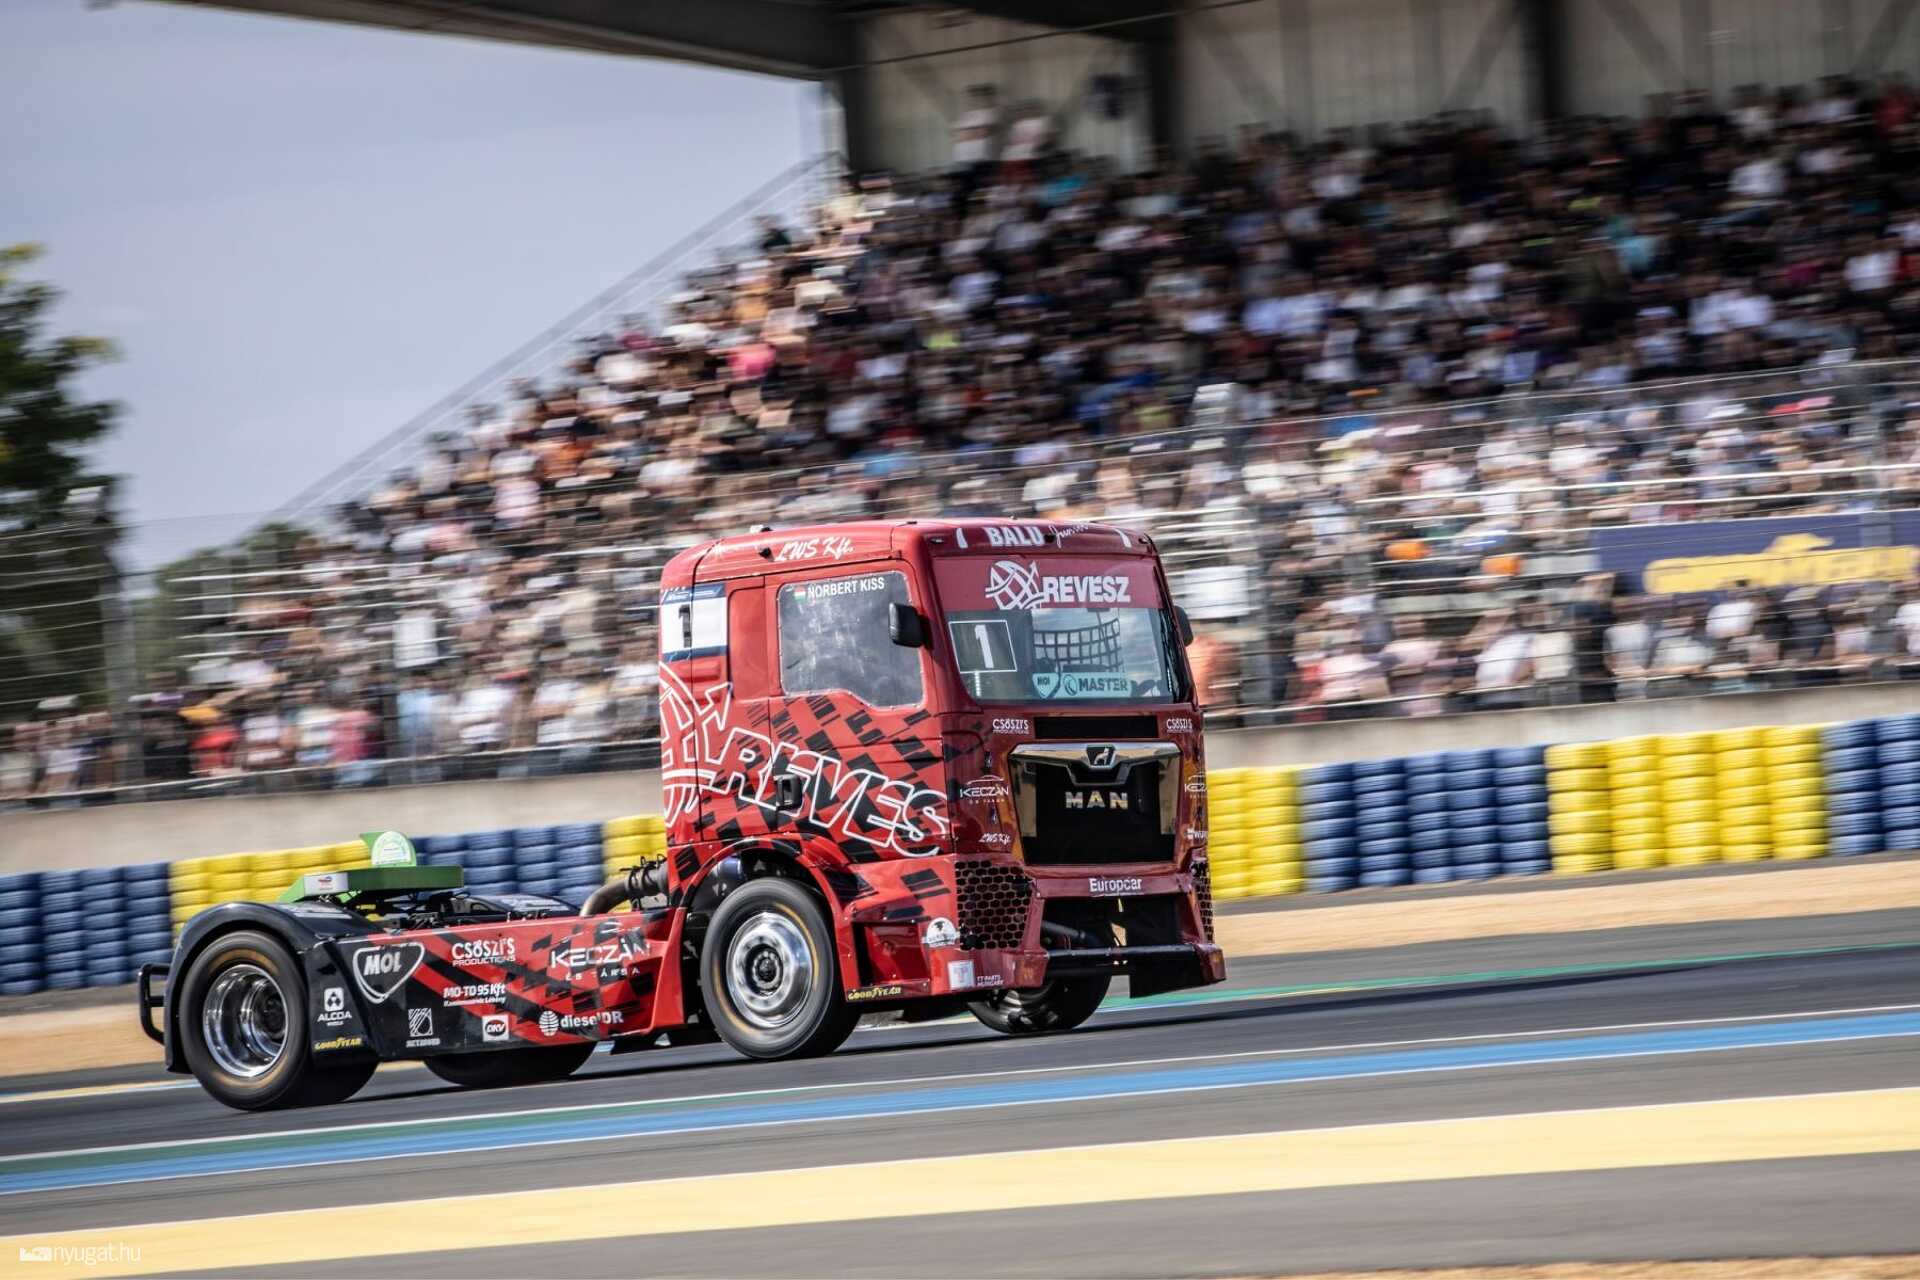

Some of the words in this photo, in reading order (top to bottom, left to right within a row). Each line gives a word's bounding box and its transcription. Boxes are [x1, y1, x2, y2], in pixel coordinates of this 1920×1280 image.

[983, 527, 1045, 546] BALU
[774, 539, 819, 561] LWS
[807, 581, 858, 598] NORBERT
[860, 577, 885, 591] KISS
[678, 603, 692, 649] 1
[975, 624, 994, 668] 1
[1078, 678, 1128, 691] MASTER
[1065, 790, 1128, 810] MAN
[1089, 877, 1142, 894] Europcar
[363, 951, 402, 976] MOL
[452, 954, 516, 967] PRODUCTIONS
[477, 983, 490, 996] 95
[490, 982, 506, 998] Kft
[848, 987, 902, 999] GOODYEAR
[317, 1011, 353, 1022] ALCOA
[314, 1037, 362, 1051] GOODYEAR
